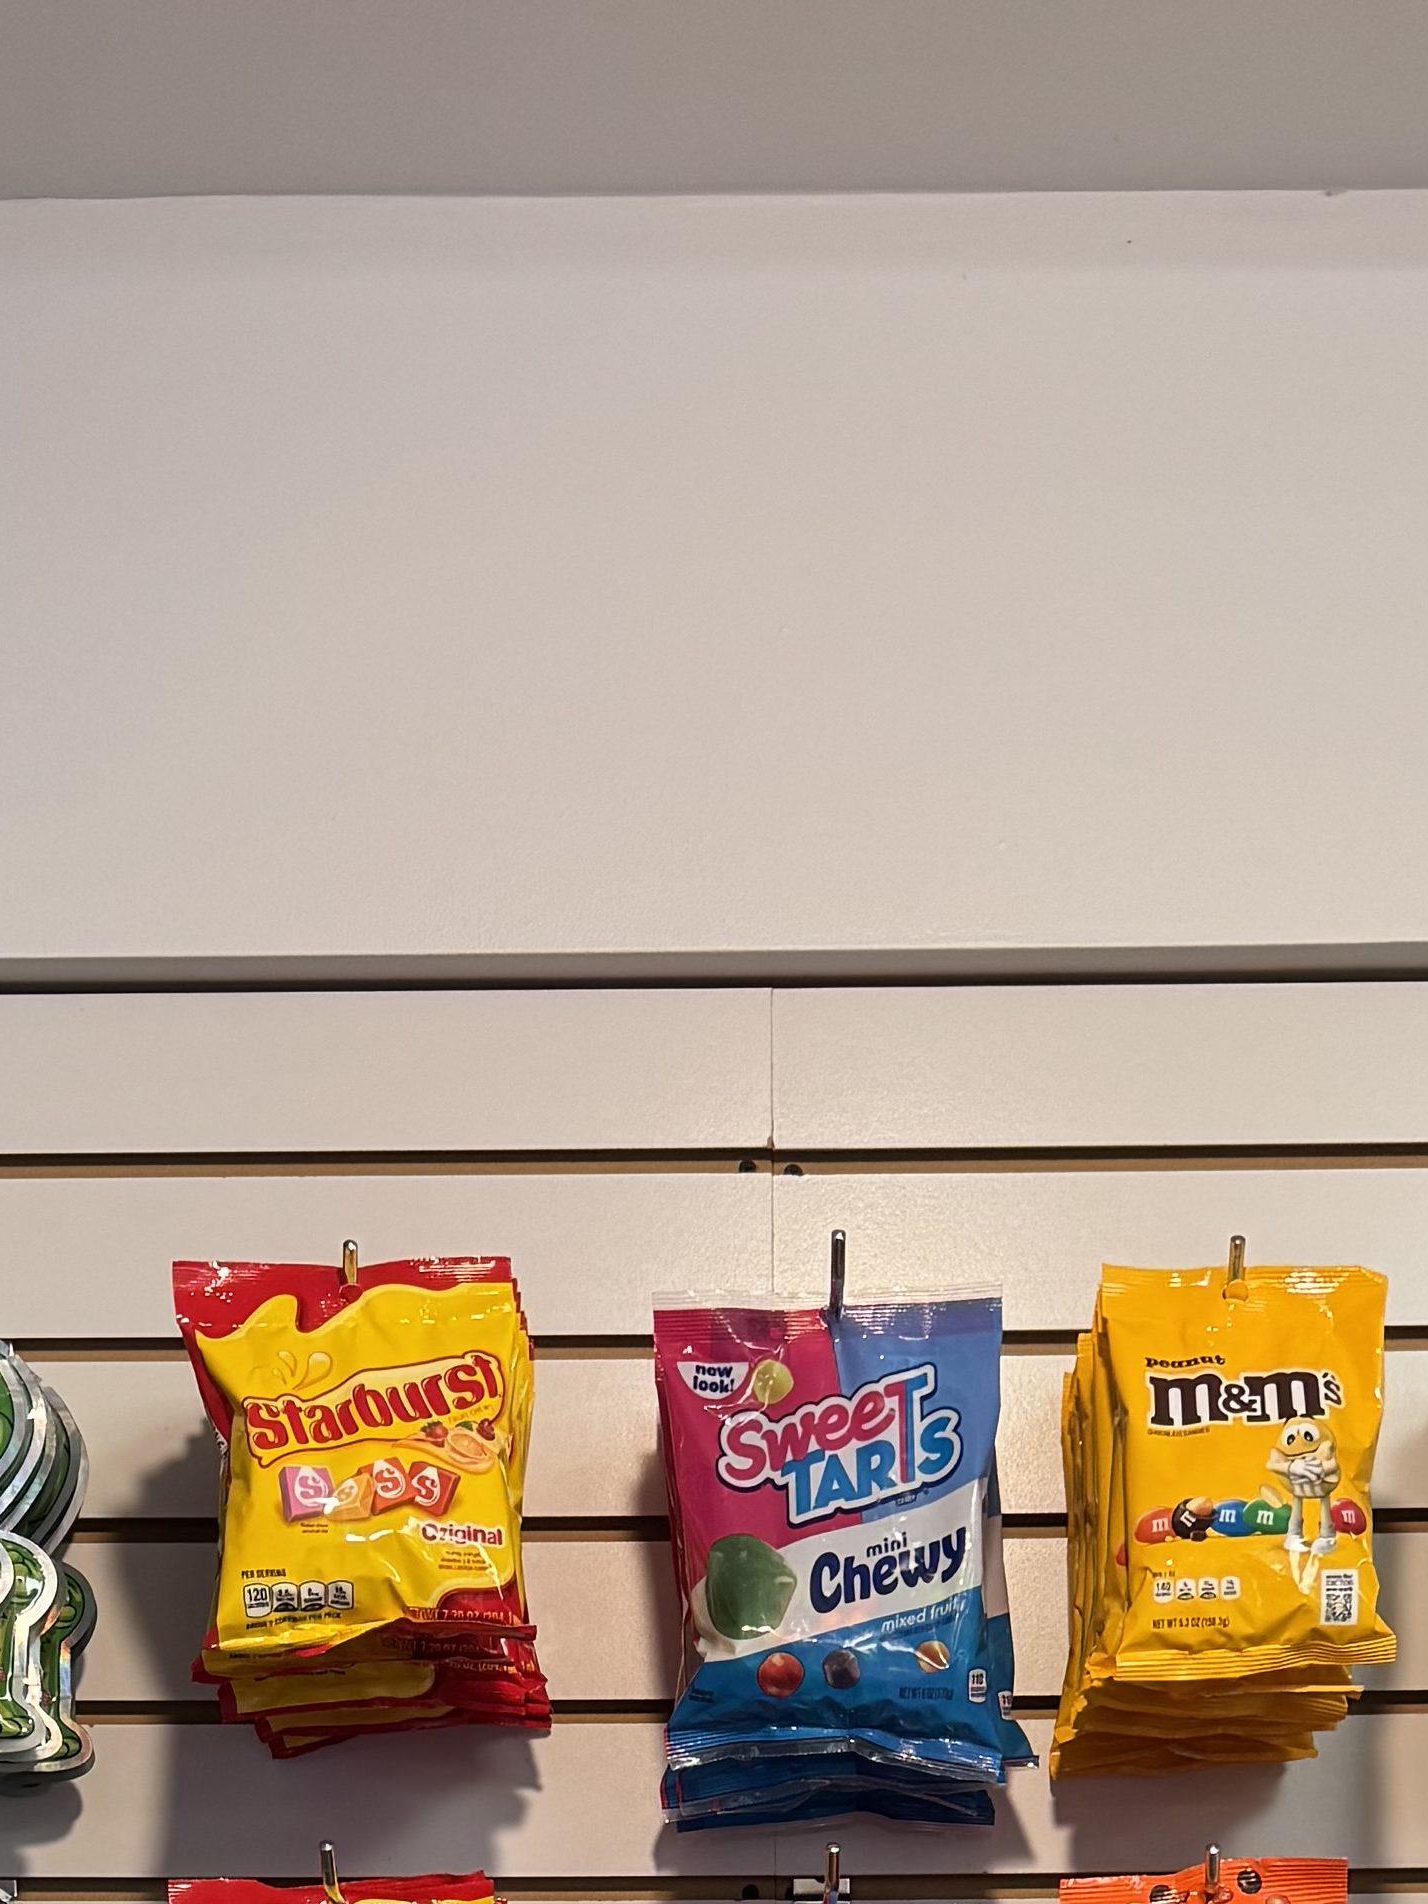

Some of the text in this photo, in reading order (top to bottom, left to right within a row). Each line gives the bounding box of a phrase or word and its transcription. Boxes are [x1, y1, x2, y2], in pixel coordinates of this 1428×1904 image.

[1145, 1355, 1226, 1370] peanut
[692, 1376, 735, 1395] look!
[245, 1354, 504, 1450] Starburst
[1149, 1371, 1342, 1428] m&m's
[422, 1522, 502, 1547] Original
[865, 1532, 909, 1558] mini
[810, 1527, 966, 1614] Chewy
